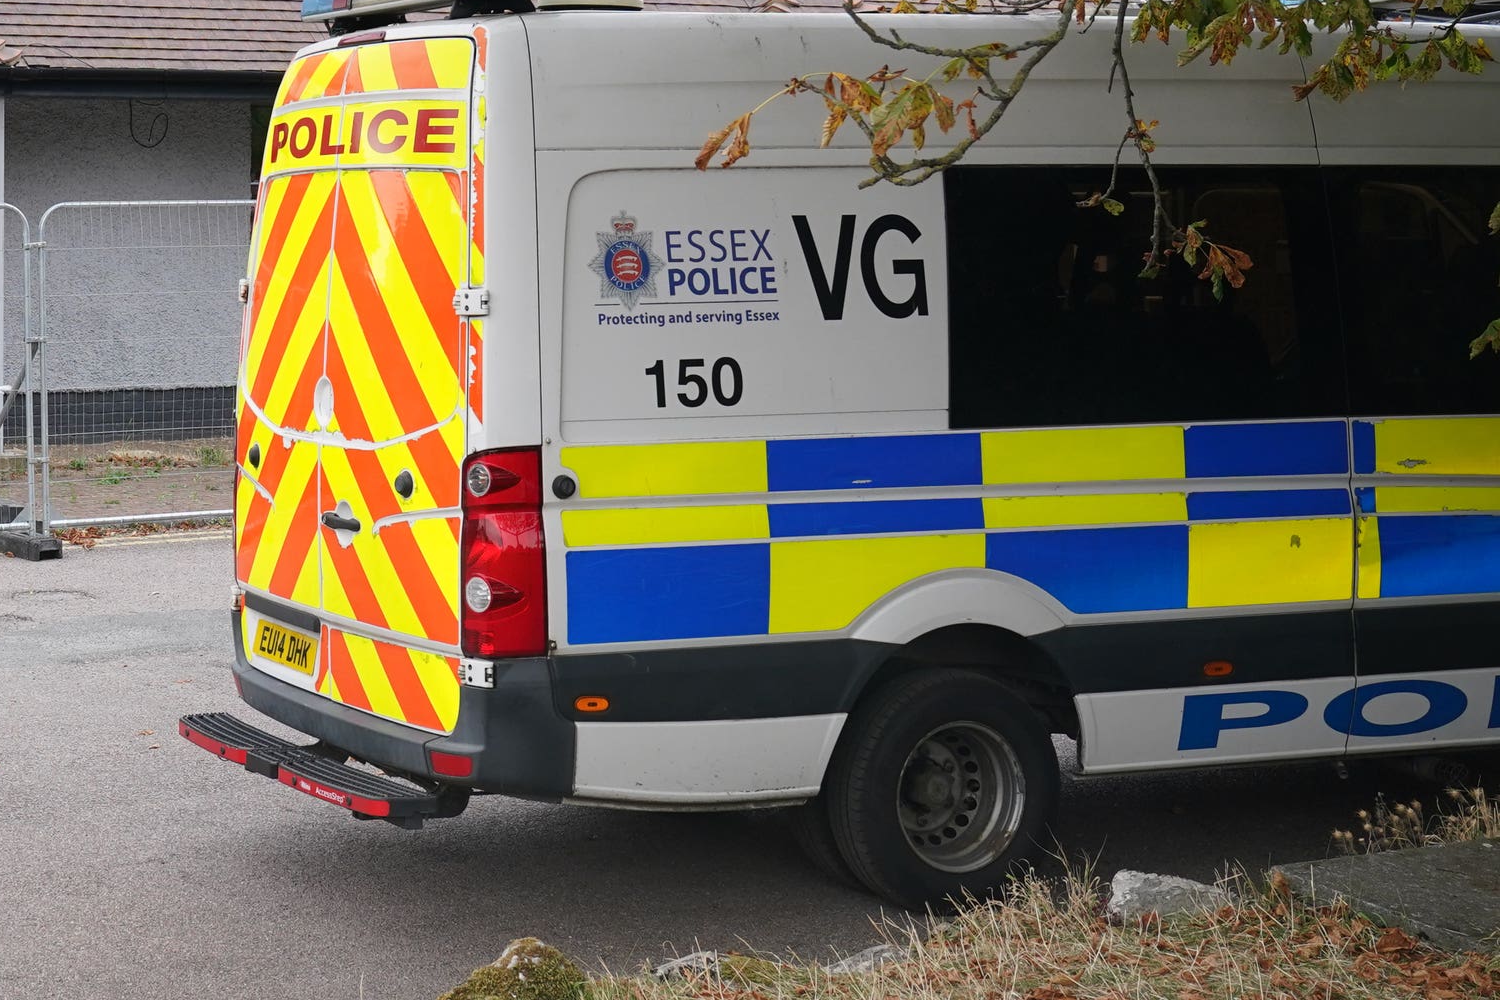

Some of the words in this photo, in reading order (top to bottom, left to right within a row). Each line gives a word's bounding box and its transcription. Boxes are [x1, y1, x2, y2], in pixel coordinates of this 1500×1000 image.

[271, 109, 459, 163] POLICE
[665, 229, 774, 263] ESSEX
[610, 275, 646, 290] POLICE
[667, 267, 778, 296] POLICE
[792, 214, 929, 321] VG
[598, 312, 665, 327] Protecting
[669, 311, 692, 323] and
[696, 311, 742, 325] serving
[746, 310, 780, 322] Essex
[645, 356, 744, 408] 150
[260, 626, 286, 658] EU14
[286, 636, 311, 669] DHK
